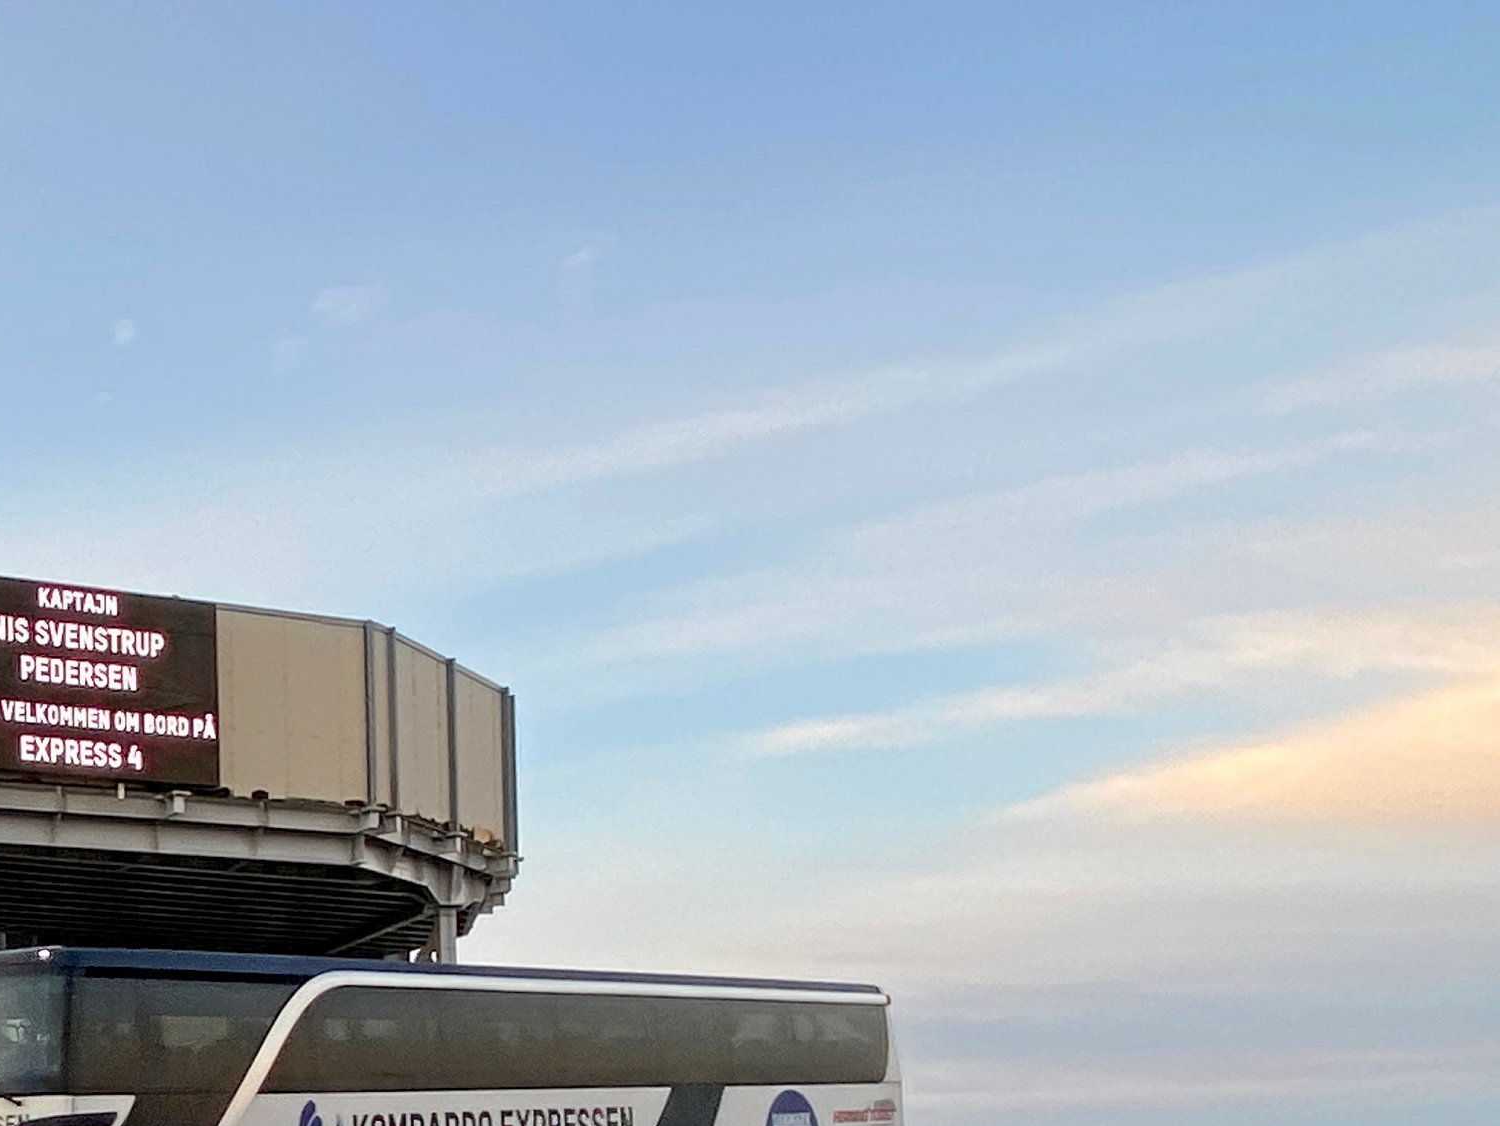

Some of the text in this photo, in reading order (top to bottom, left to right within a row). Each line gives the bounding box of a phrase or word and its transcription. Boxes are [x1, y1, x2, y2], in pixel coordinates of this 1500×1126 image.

[37, 587, 118, 616] KAPTAJN
[34, 616, 165, 658] SVENSTRUP
[19, 654, 138, 692] PEDERSEN
[1, 698, 111, 732] VELKOMMEN
[114, 712, 140, 733] OM
[144, 713, 189, 738] BORD
[193, 713, 217, 740] PÅ
[19, 734, 143, 771] EXPRESS 4
